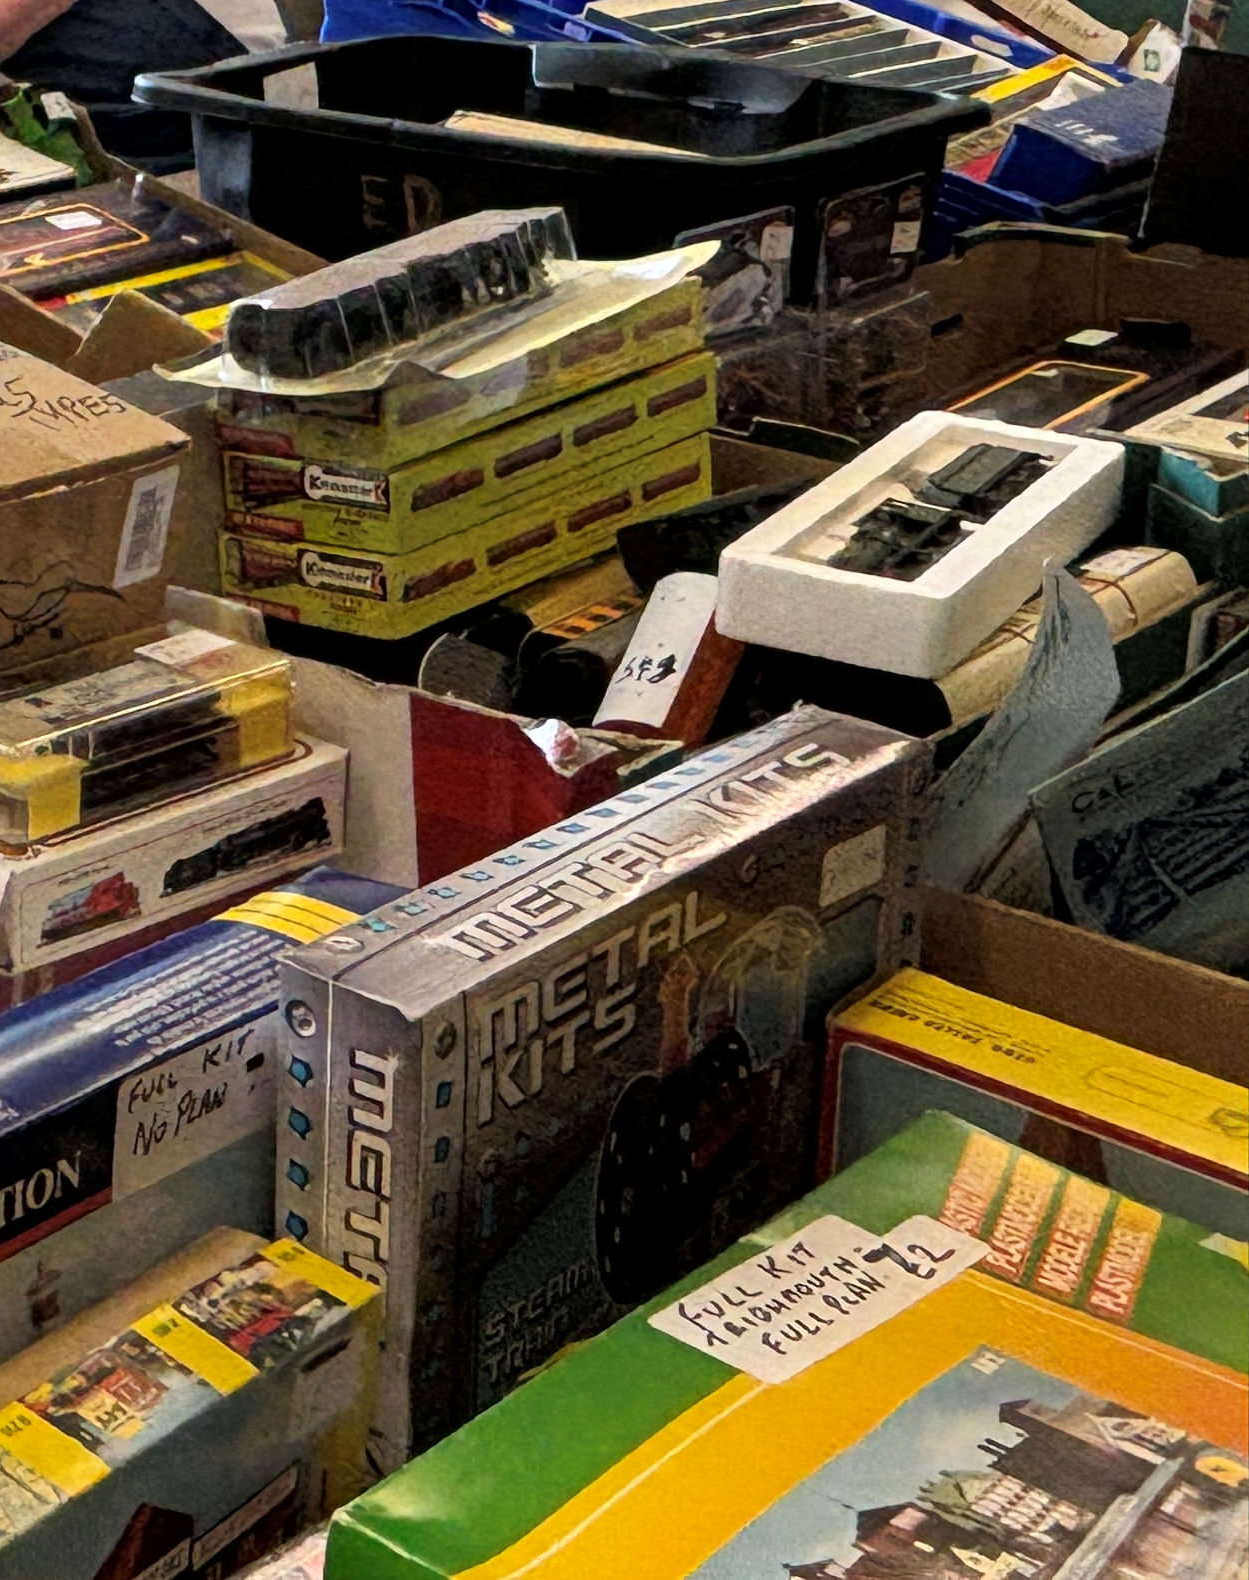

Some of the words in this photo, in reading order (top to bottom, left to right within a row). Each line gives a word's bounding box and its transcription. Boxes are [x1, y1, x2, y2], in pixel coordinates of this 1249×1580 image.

[451, 830, 706, 963] METAL
[691, 741, 857, 824] KITS
[477, 890, 728, 1060] METAL
[202, 1028, 256, 1074] KIT
[477, 982, 638, 1127] KITS
[132, 1111, 168, 1156] NO
[173, 1081, 229, 1138] PLAN
[678, 1285, 763, 1332] FULL
[757, 1241, 817, 1280] KIT
[762, 1311, 835, 1355] FULL
[822, 1270, 887, 1315] PLAN
